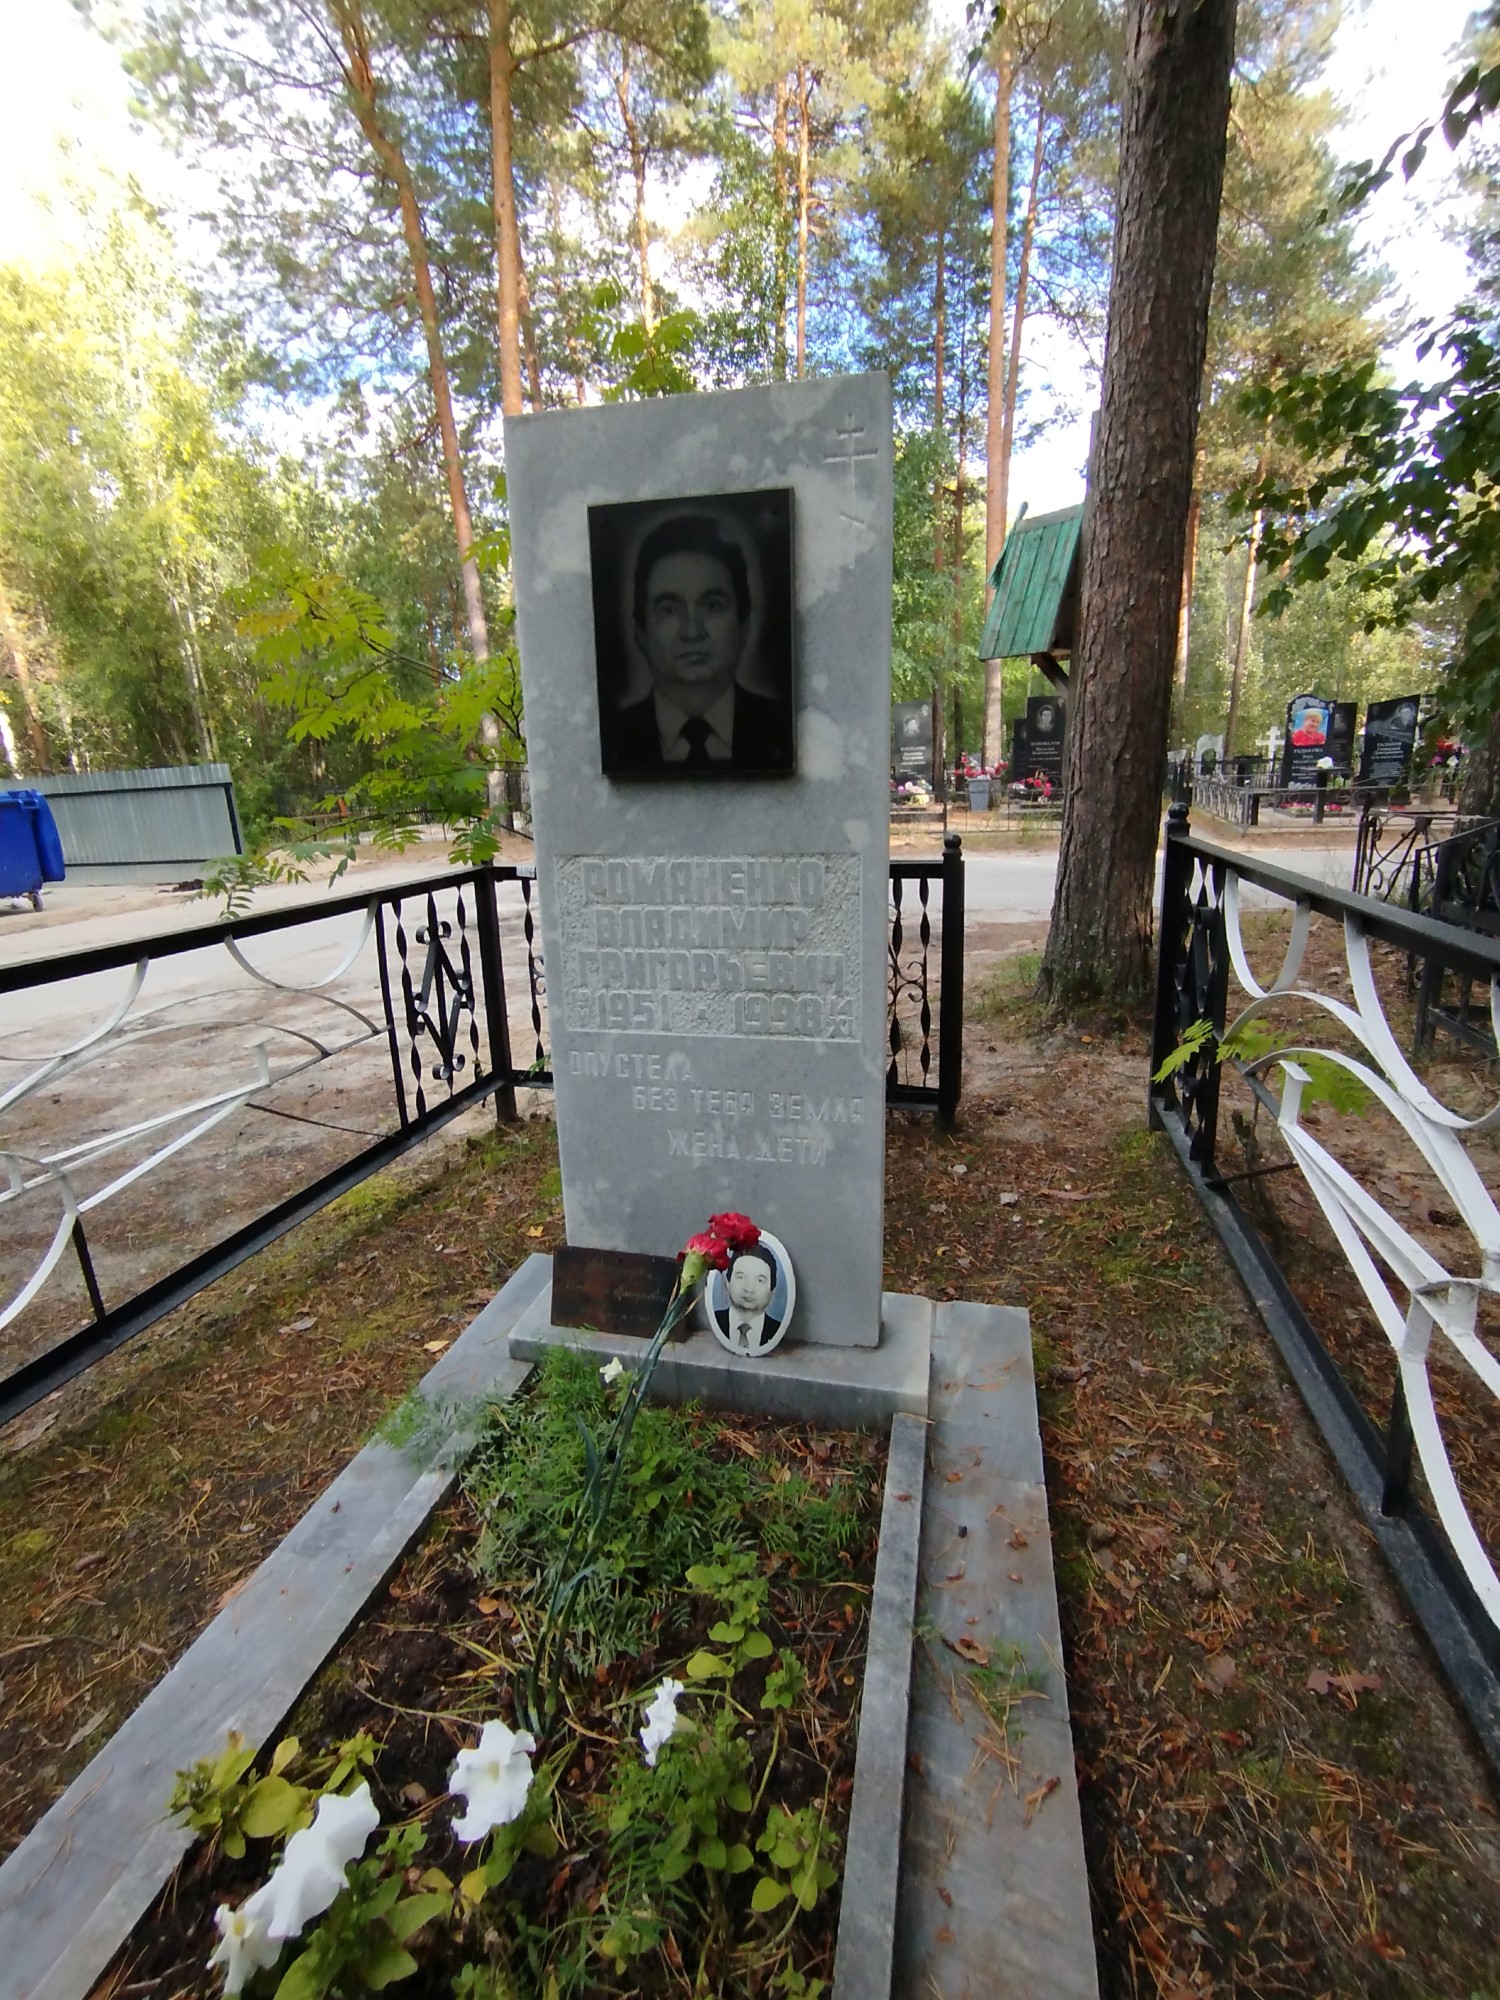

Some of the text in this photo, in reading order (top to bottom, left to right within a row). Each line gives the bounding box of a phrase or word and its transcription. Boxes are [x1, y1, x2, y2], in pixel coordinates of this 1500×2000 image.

[581, 858, 825, 904] РОМАНЕНКО
[595, 905, 811, 950] ВЛАДИМИР
[577, 948, 846, 993] ГРИГОРЬЕВИЧ
[597, 989, 671, 1032] 1951
[733, 993, 823, 1037] 1998
[568, 1048, 695, 1081] ОПУСТЕЛА
[632, 1084, 864, 1123] БЕЗ ТЕБЯ ЗЕМЛЯ
